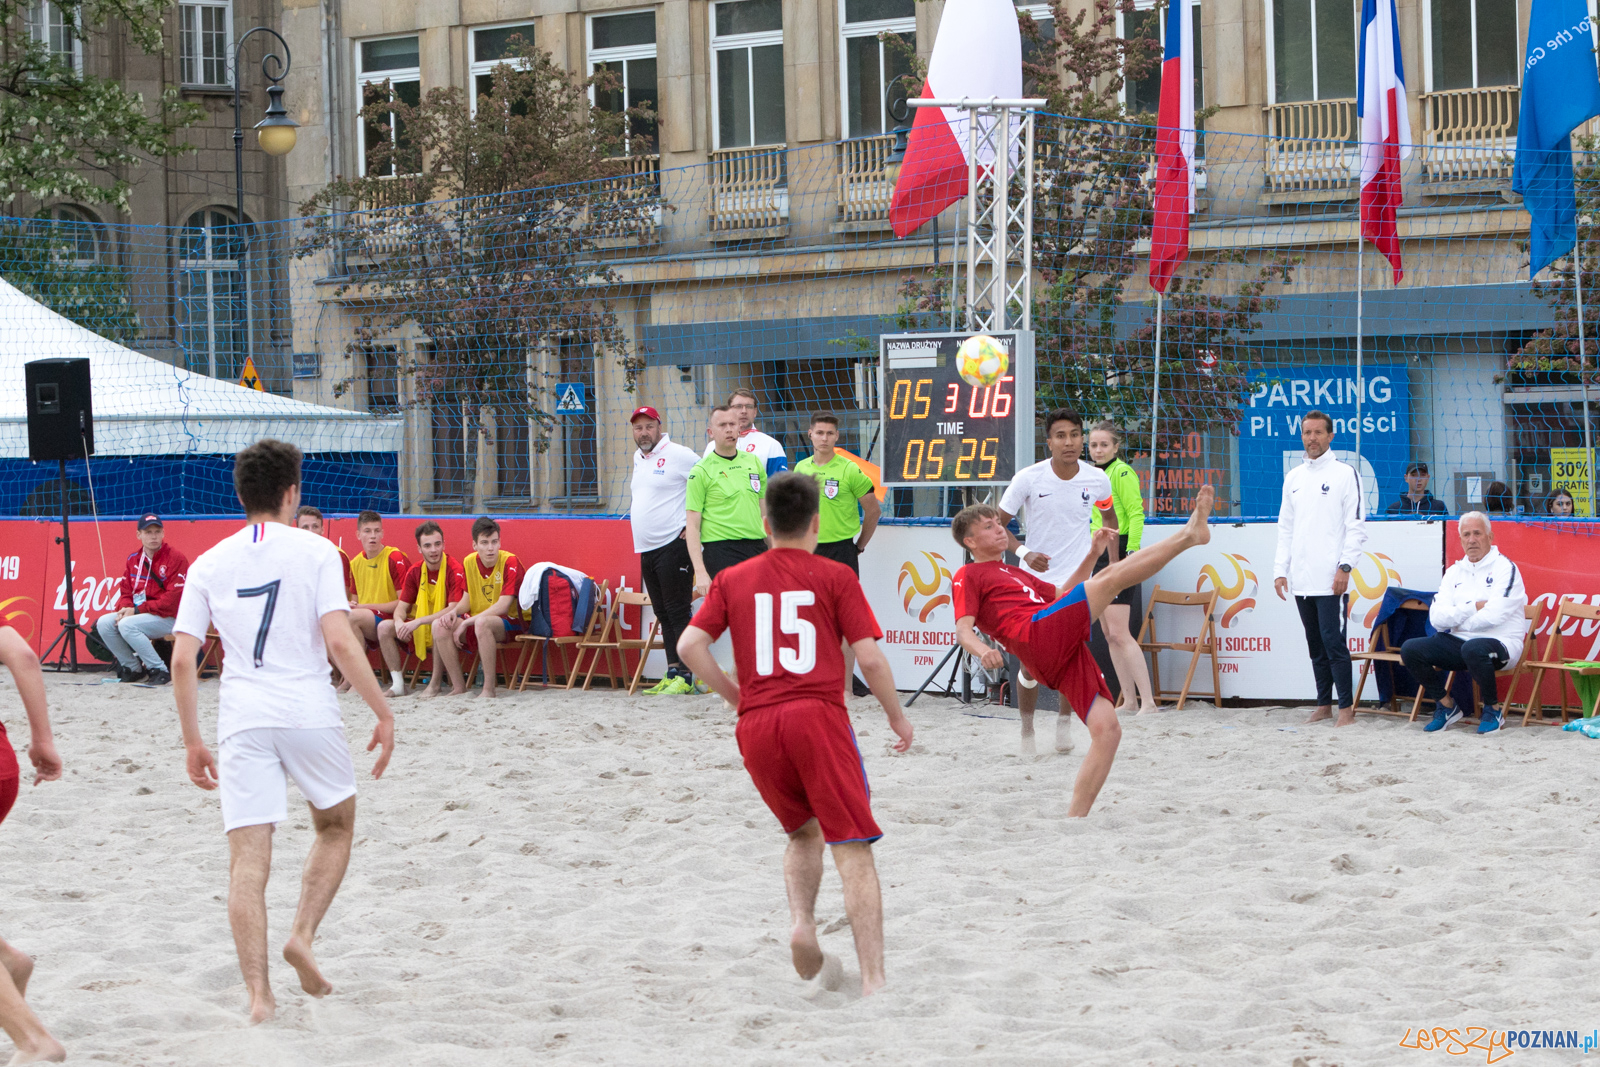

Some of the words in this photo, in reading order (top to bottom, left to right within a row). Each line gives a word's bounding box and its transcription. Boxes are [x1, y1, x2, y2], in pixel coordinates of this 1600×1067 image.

[887, 341, 910, 350] NAZWA
[911, 339, 942, 349] DRUŻYNY
[889, 379, 933, 419] 05
[944, 383, 959, 413] 3
[968, 376, 1014, 418] 06
[1250, 375, 1392, 408] PARKING
[936, 421, 964, 435] TIME
[1251, 416, 1279, 437] Pl.
[1286, 411, 1397, 436] Wności
[902, 439, 946, 479] 05
[236, 579, 281, 669] 7
[754, 590, 817, 676] 15
[886, 630, 920, 645] BEACH
[922, 631, 956, 646] SOCCE
[1225, 636, 1271, 652] SOCCER
[914, 655, 934, 666] PZPN
[1217, 662, 1239, 673] PZPN
